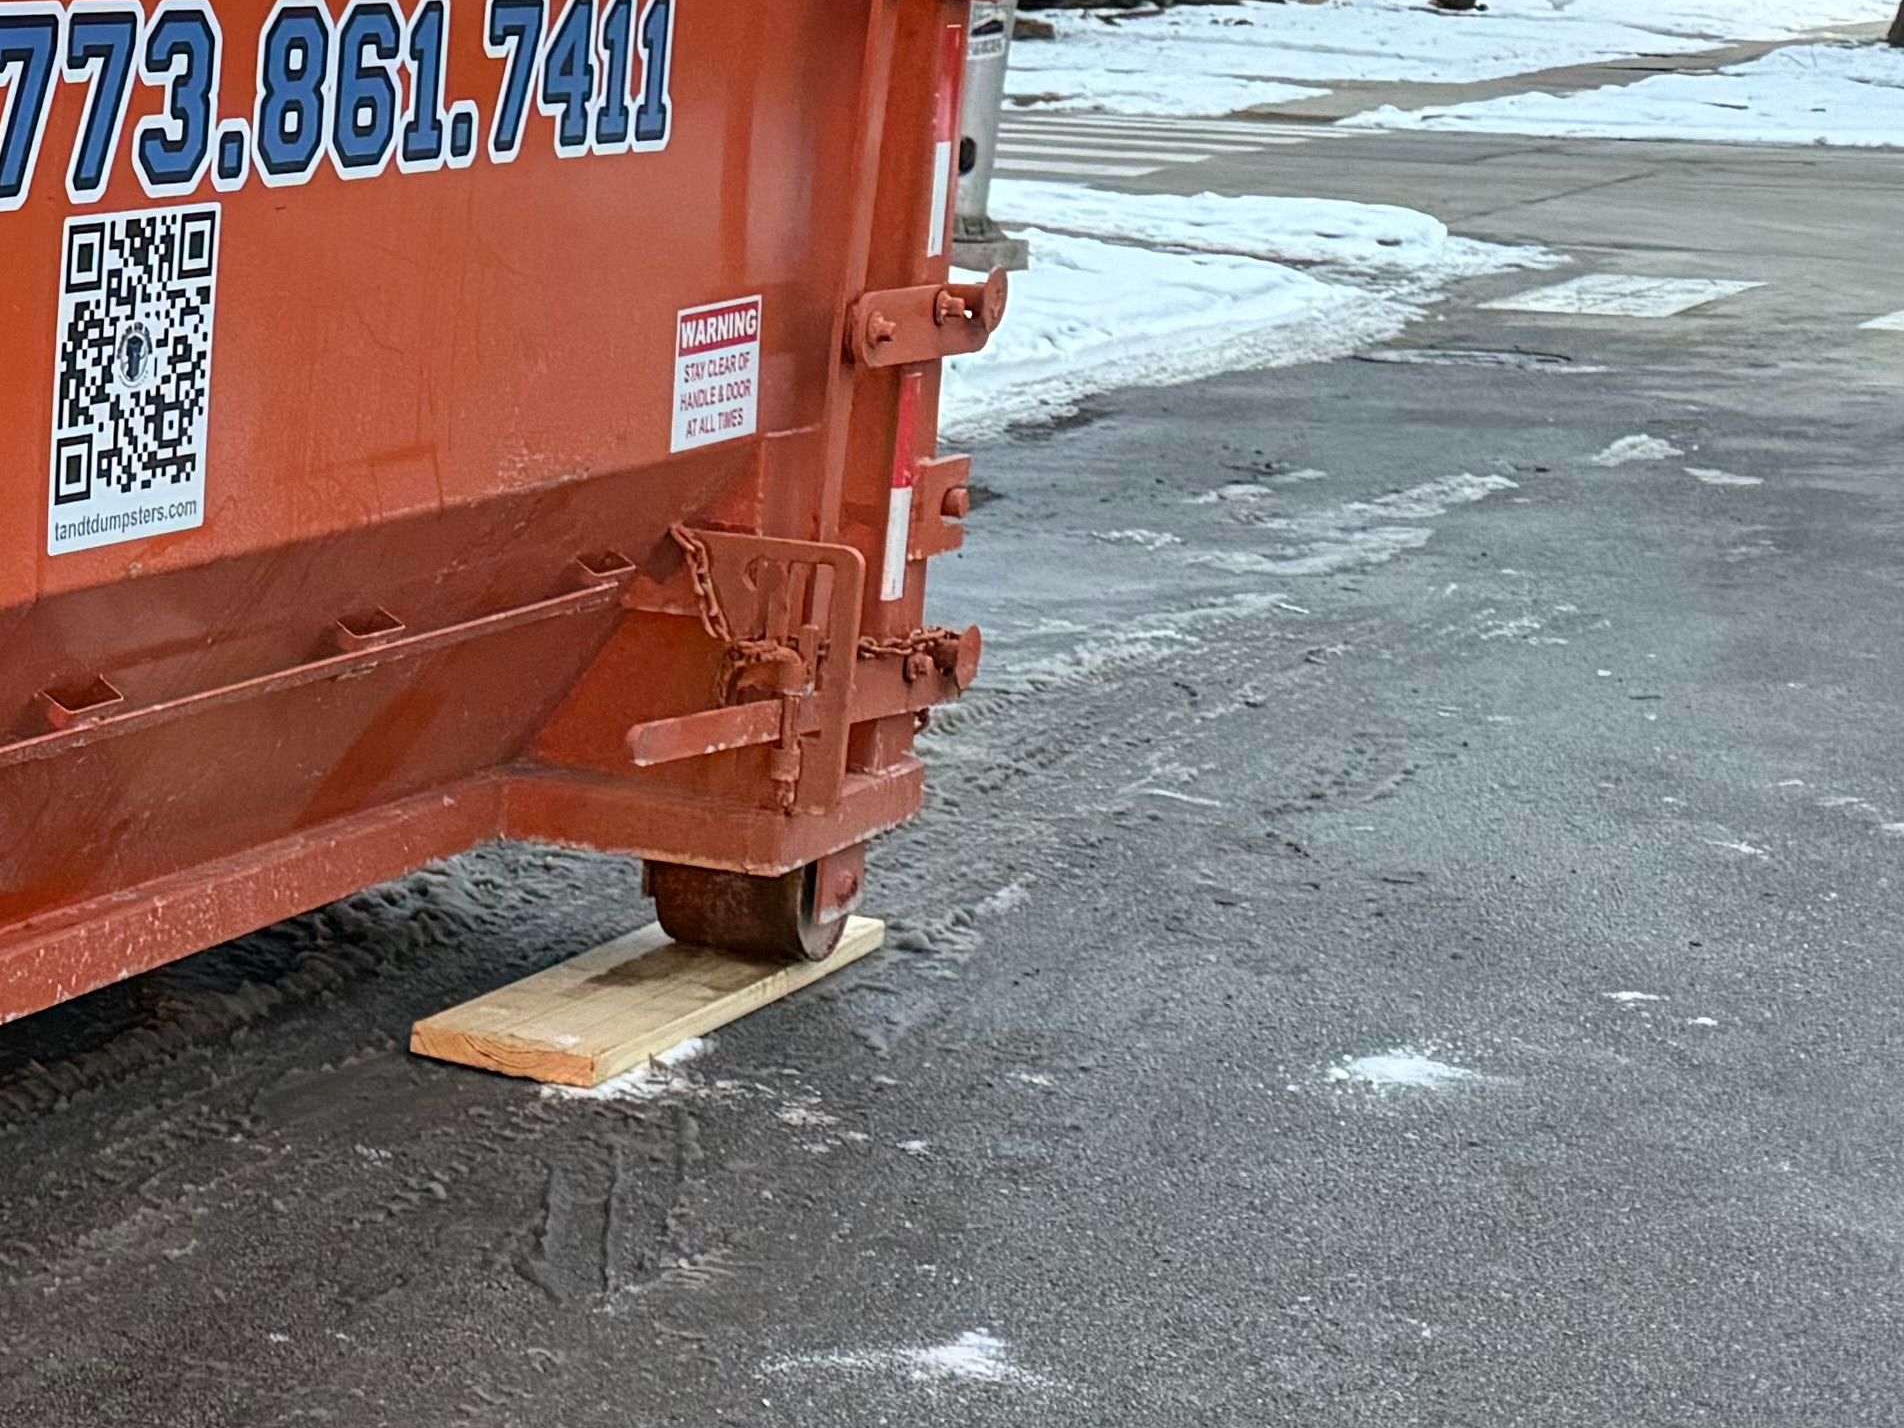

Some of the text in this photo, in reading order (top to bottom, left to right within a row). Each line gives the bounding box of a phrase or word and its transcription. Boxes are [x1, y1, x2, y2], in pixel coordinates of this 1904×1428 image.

[681, 309, 757, 349] WARNING
[684, 351, 749, 382] STAY CLEAR OF
[680, 378, 750, 410] HANDLE & DOOR
[685, 407, 742, 436] AT ALL TIMES
[54, 500, 197, 542] tandtdumpsters.com
